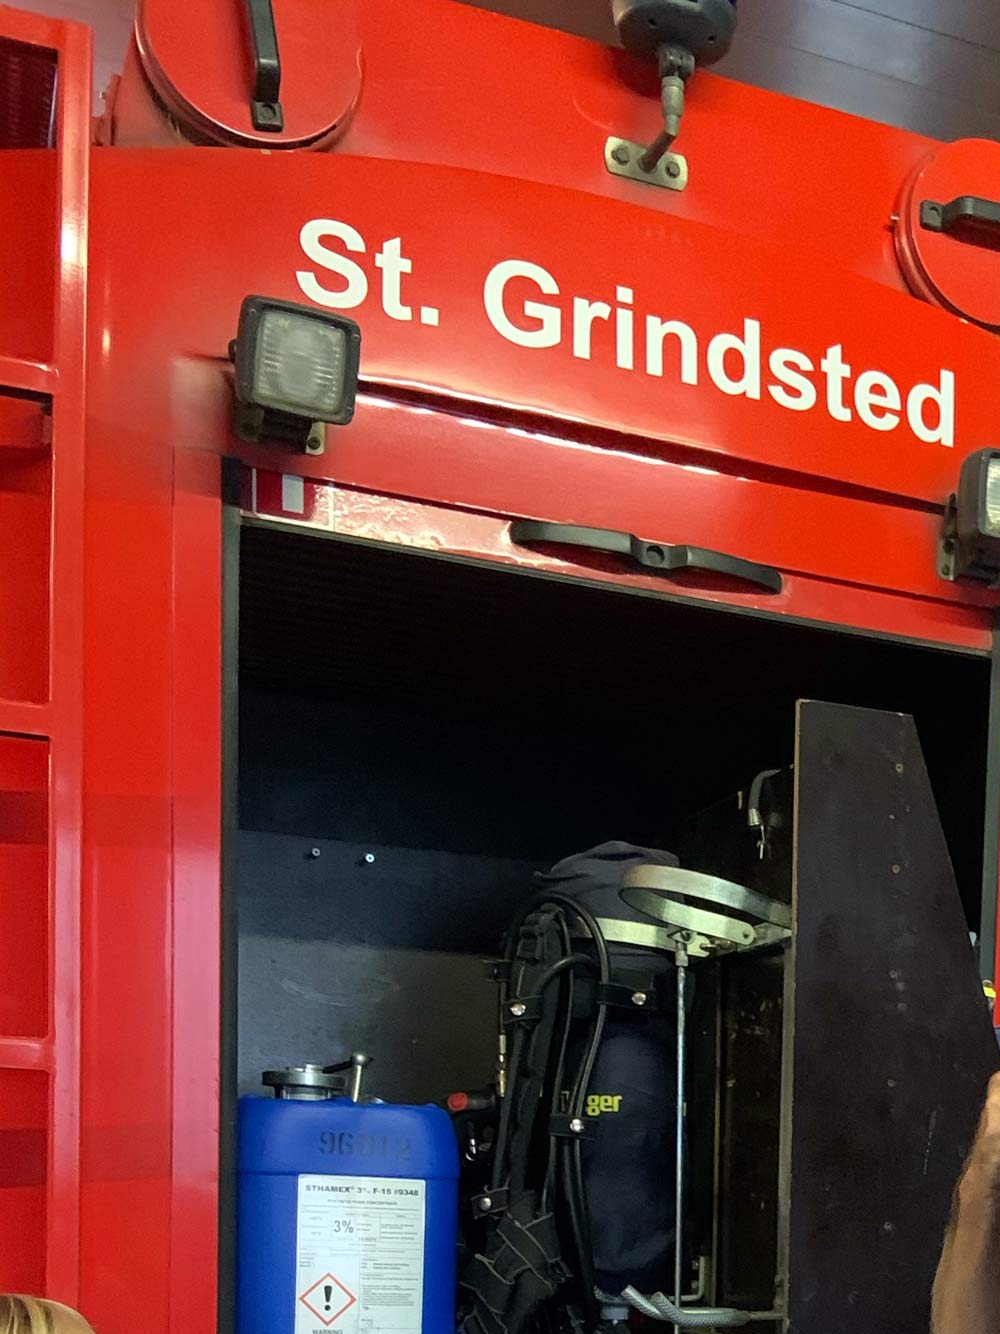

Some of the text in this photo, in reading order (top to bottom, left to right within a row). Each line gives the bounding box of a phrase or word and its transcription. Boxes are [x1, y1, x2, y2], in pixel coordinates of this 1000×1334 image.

[295, 218, 956, 448] St. Grindsted
[333, 1219, 354, 1234] 3%
